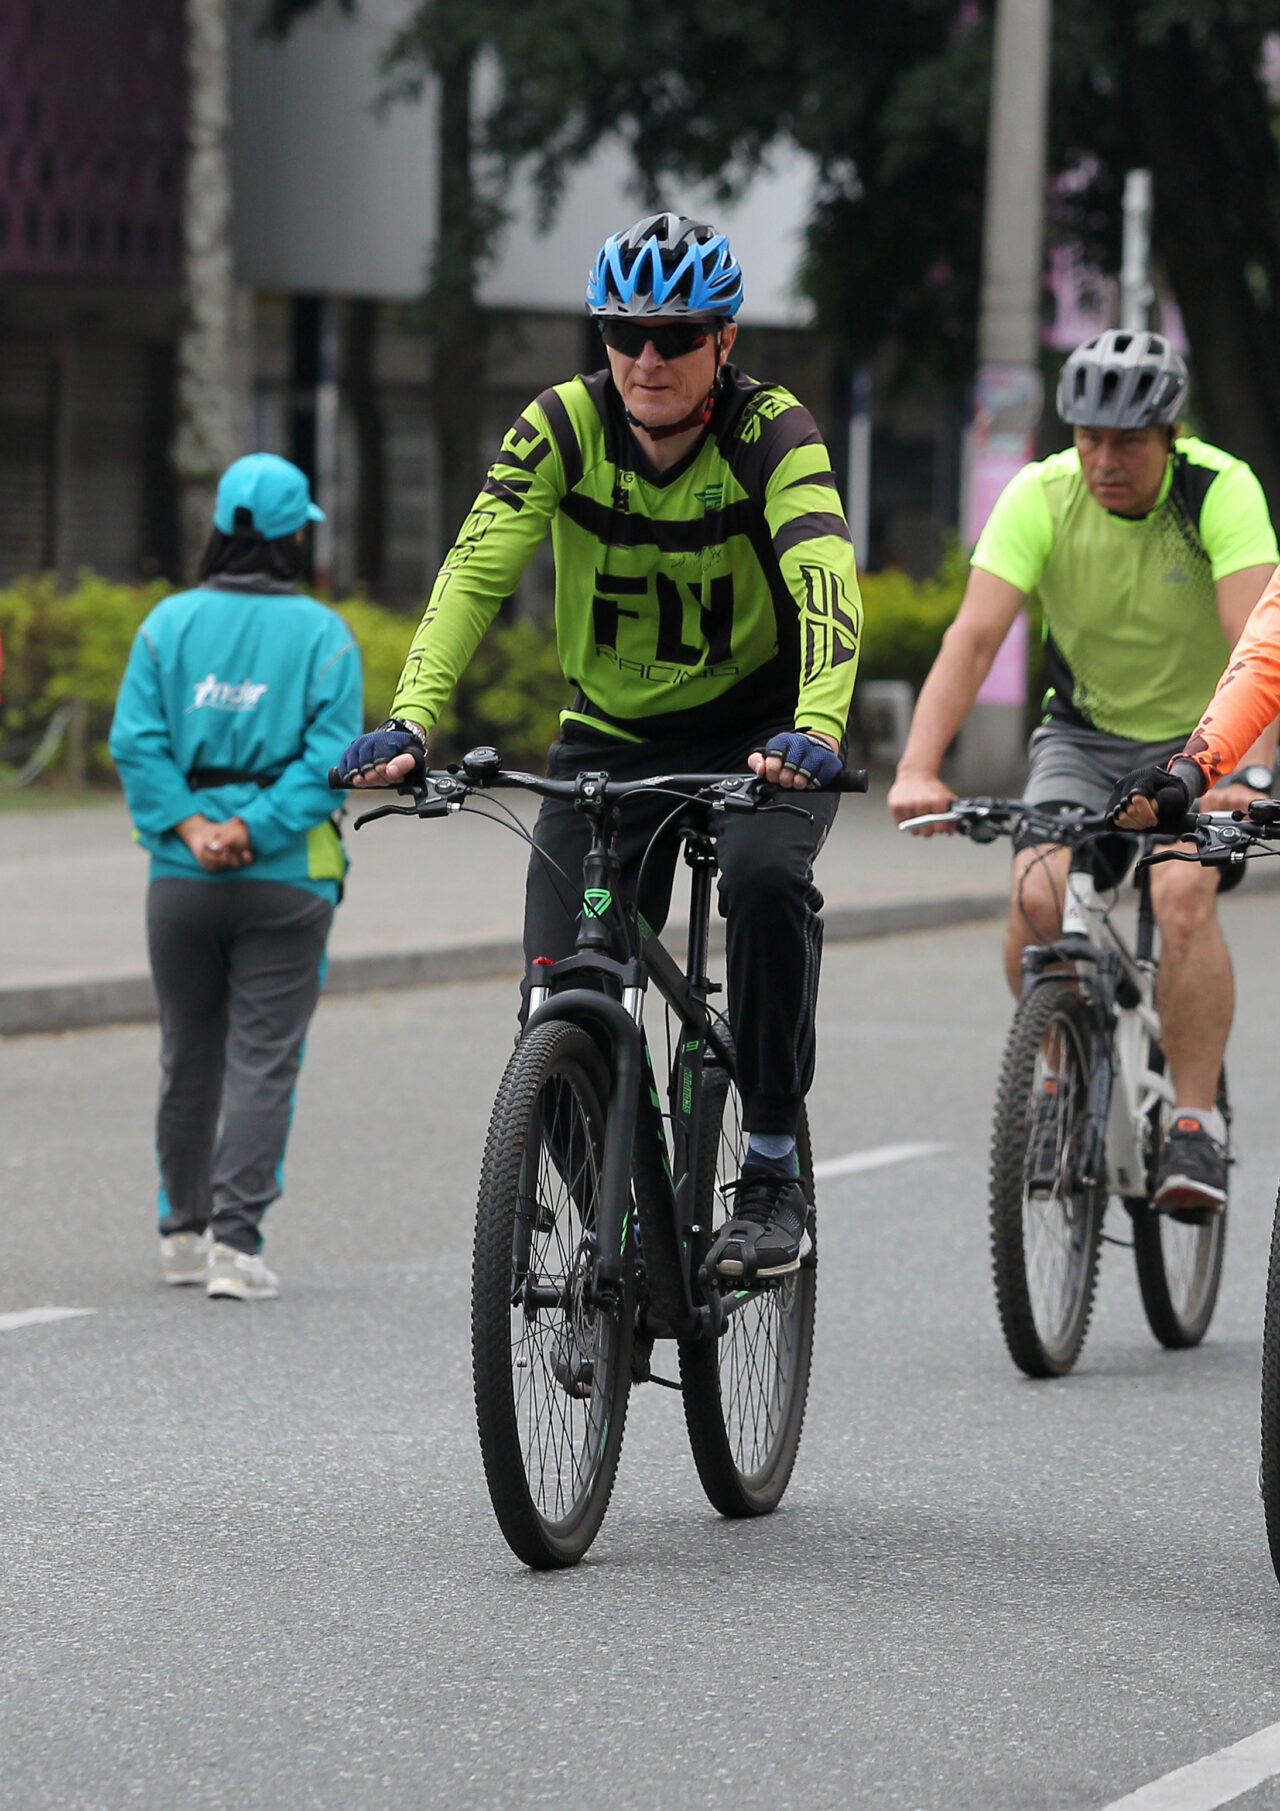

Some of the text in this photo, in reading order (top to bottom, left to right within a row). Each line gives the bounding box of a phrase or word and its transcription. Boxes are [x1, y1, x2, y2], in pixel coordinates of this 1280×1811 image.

[592, 566, 734, 666] FLY
[595, 645, 740, 685] RACING
[682, 1066, 692, 1114] SCORPION
